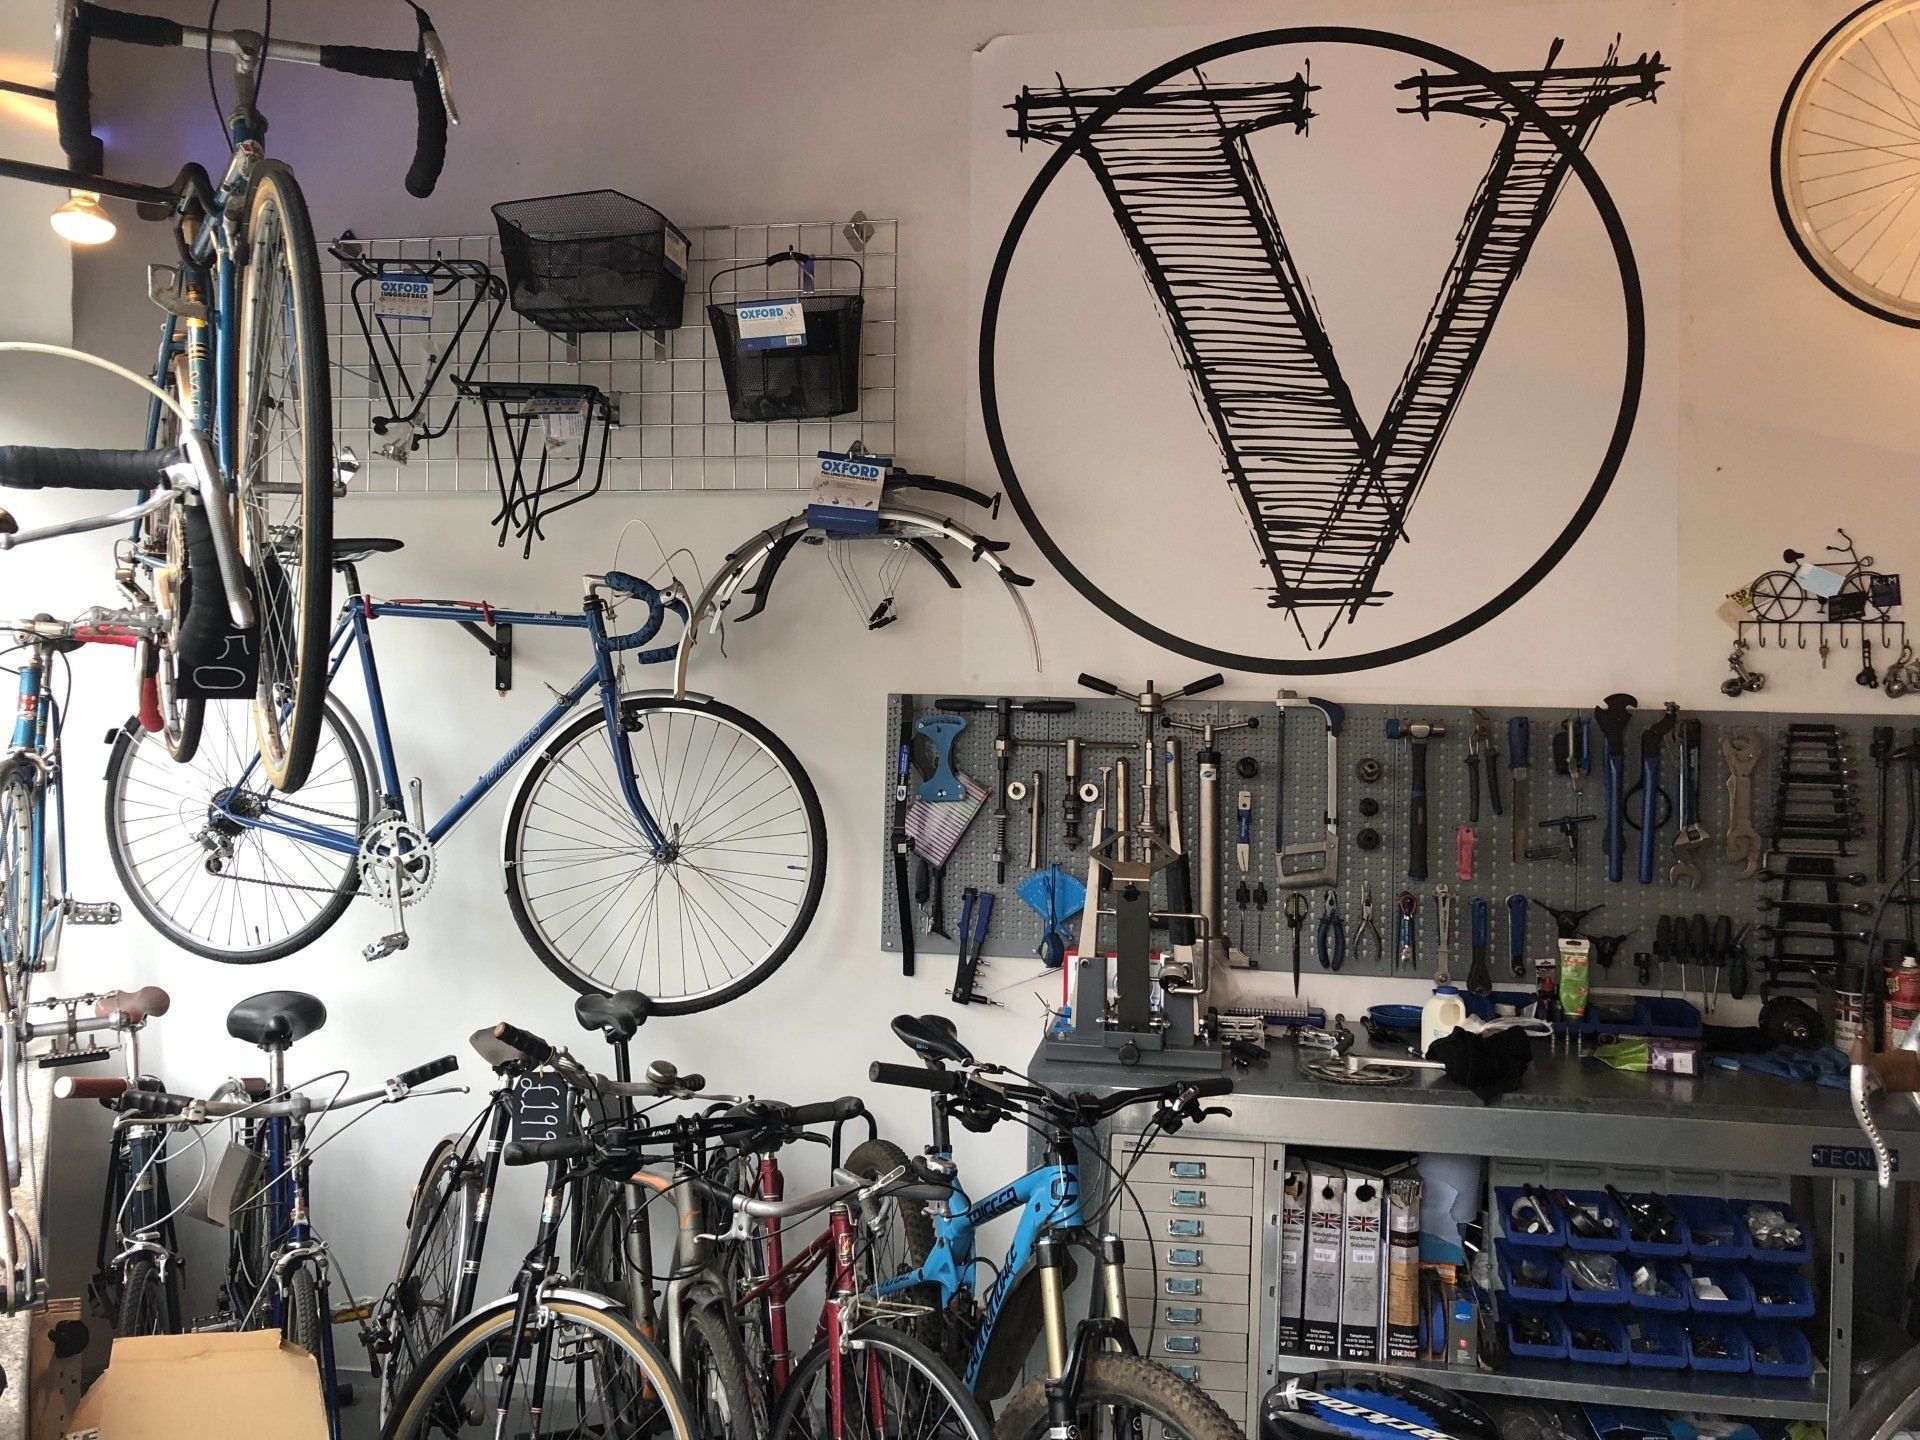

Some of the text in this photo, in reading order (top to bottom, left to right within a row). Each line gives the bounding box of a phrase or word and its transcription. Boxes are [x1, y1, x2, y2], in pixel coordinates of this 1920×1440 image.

[380, 282, 428, 294] OXFORD
[740, 308, 784, 320] OXFORD
[821, 460, 879, 478] OXFORD
[486, 725, 541, 786] DAWES
[520, 1077, 560, 1141] £199
[651, 1129, 671, 1138] UNO
[1816, 1147, 1872, 1168] TECN
[1312, 1231, 1340, 1239] Workshop
[1349, 1234, 1377, 1242] Workshop
[1350, 1241, 1376, 1249] Solutions
[1409, 1389, 1448, 1408] SHOP
